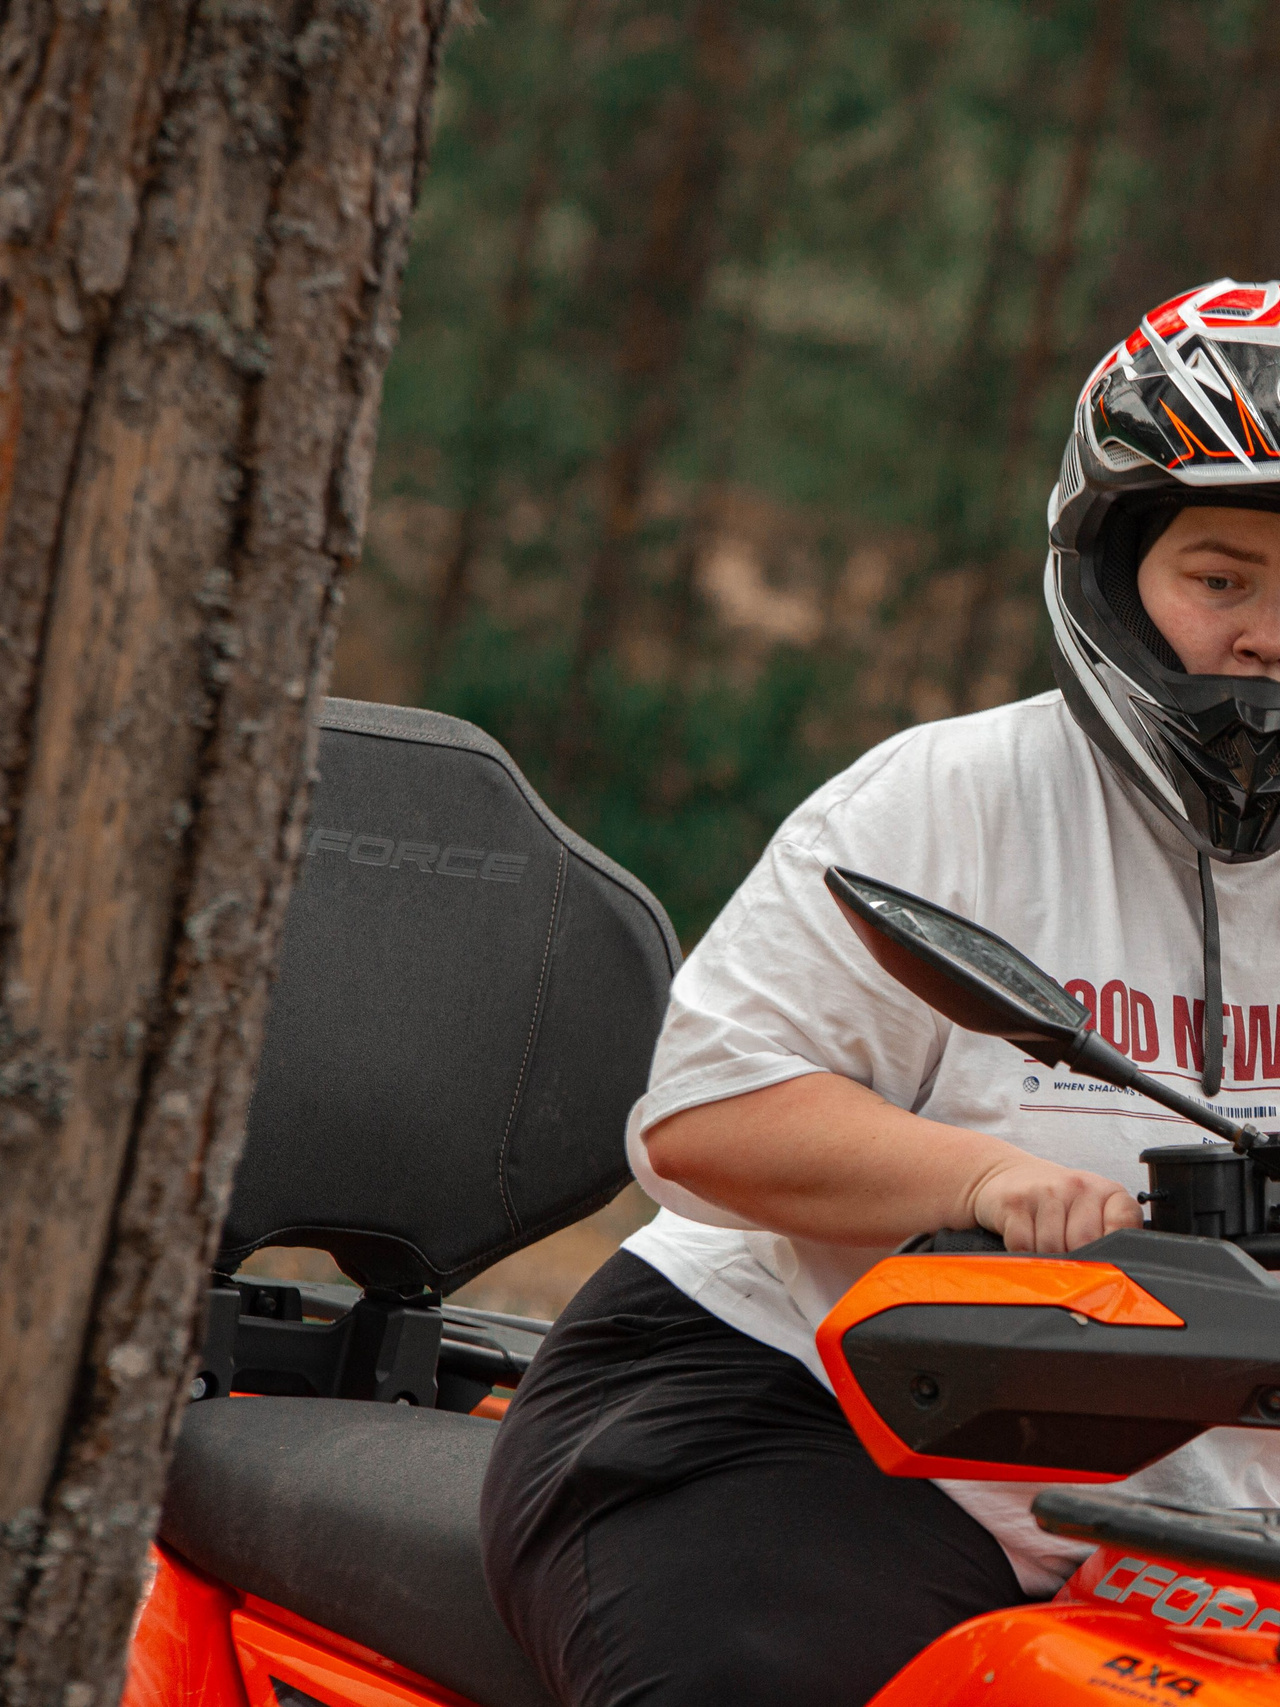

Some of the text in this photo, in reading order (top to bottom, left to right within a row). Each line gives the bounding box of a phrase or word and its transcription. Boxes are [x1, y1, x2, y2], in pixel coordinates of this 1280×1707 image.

[305, 829, 529, 884] FORCE
[1050, 976, 1160, 1064] OOD
[1053, 1081, 1085, 1092] WHEN
